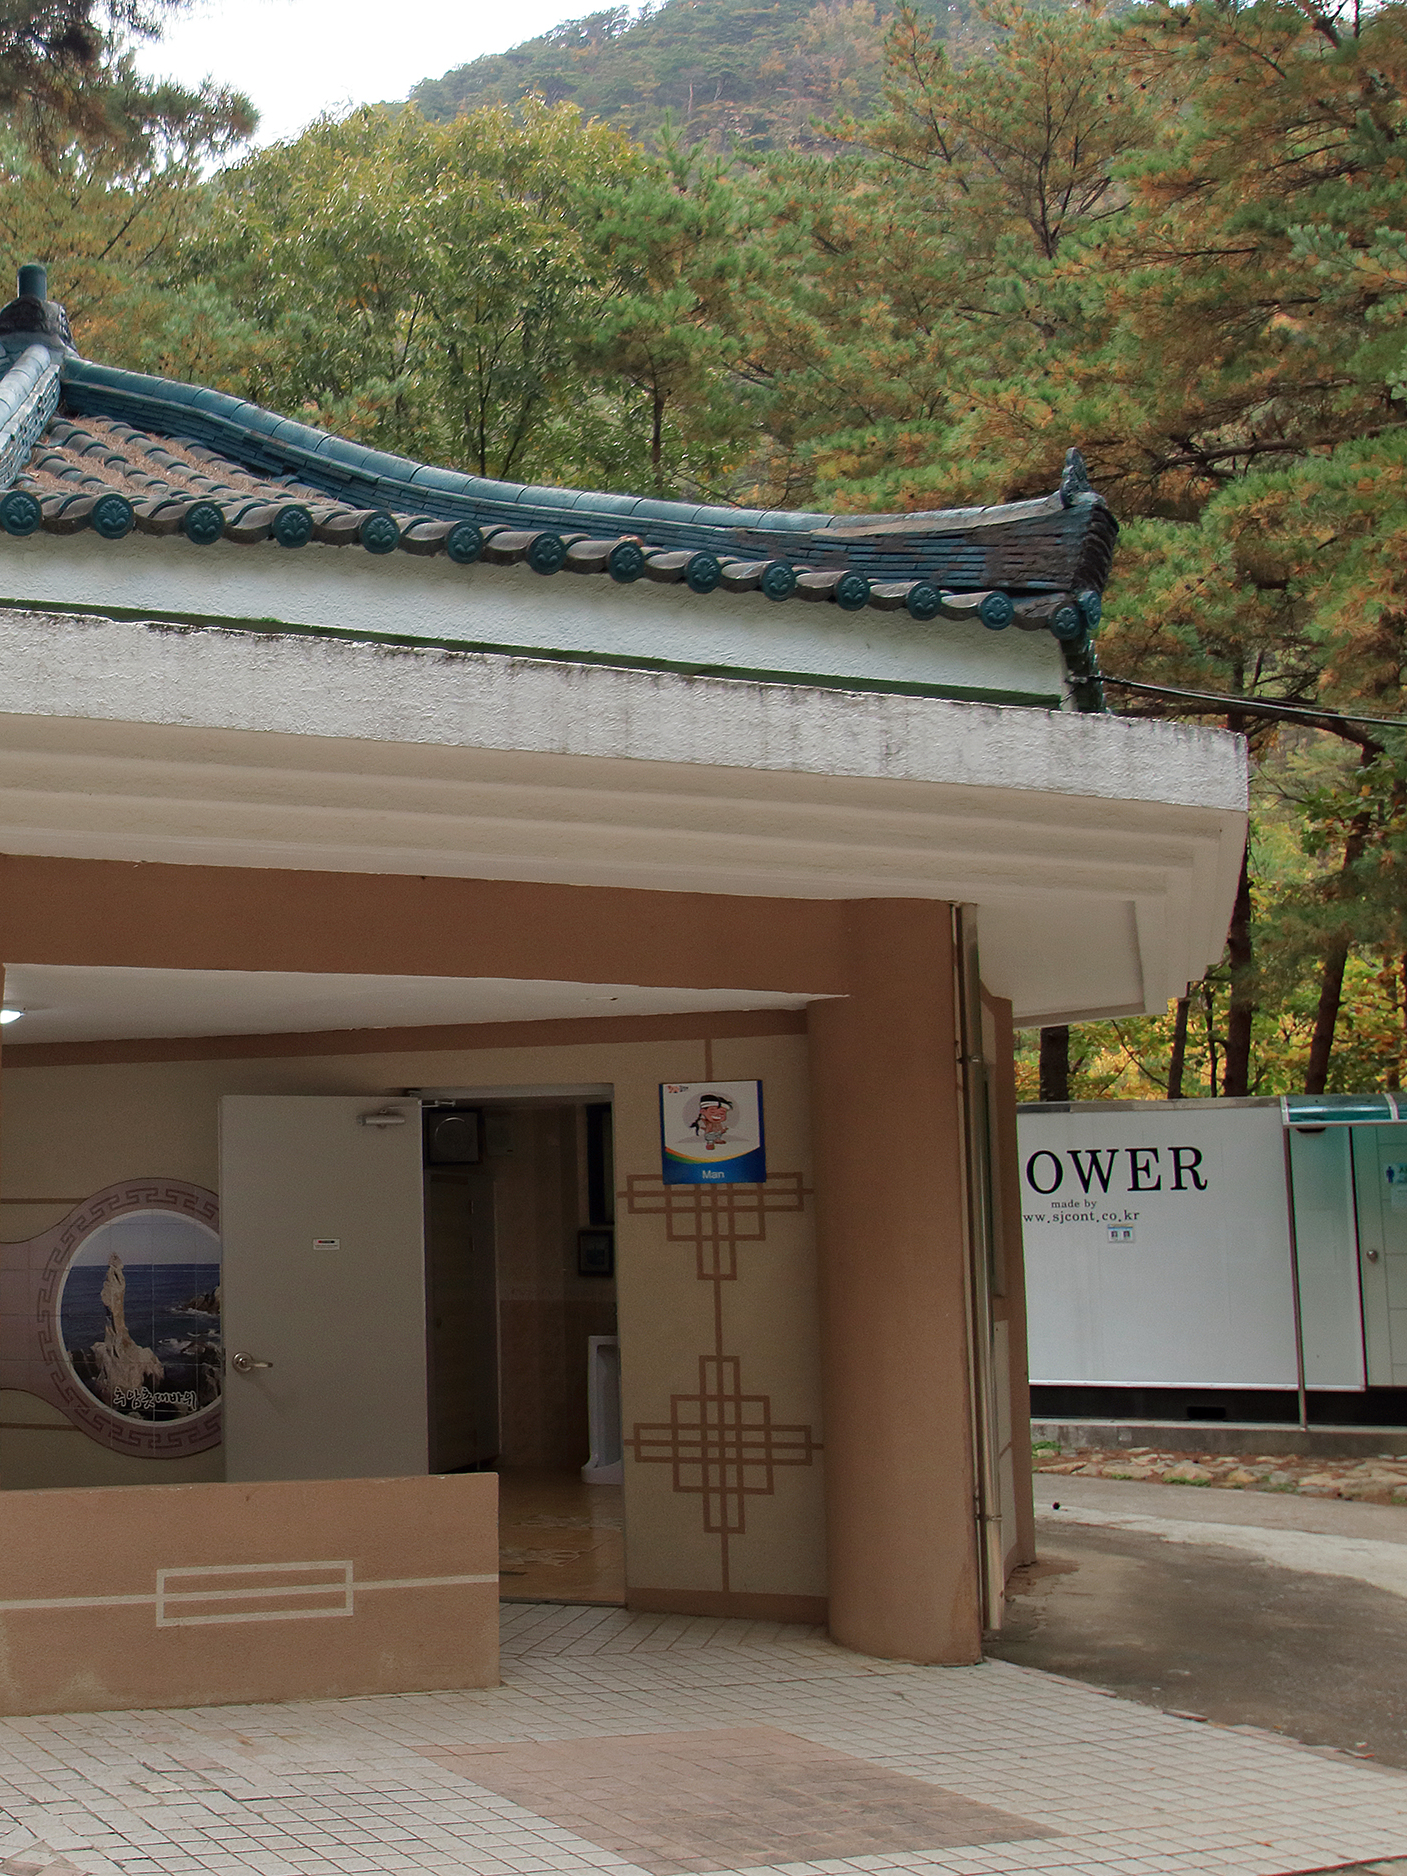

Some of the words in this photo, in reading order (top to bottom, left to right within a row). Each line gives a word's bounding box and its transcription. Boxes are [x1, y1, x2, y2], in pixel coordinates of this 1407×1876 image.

[702, 1170, 725, 1179] Man
[1026, 1146, 1208, 1195] OWER
[1051, 1199, 1080, 1208] made
[1084, 1199, 1097, 1210] by
[113, 1385, 197, 1411] 추암촛대바위
